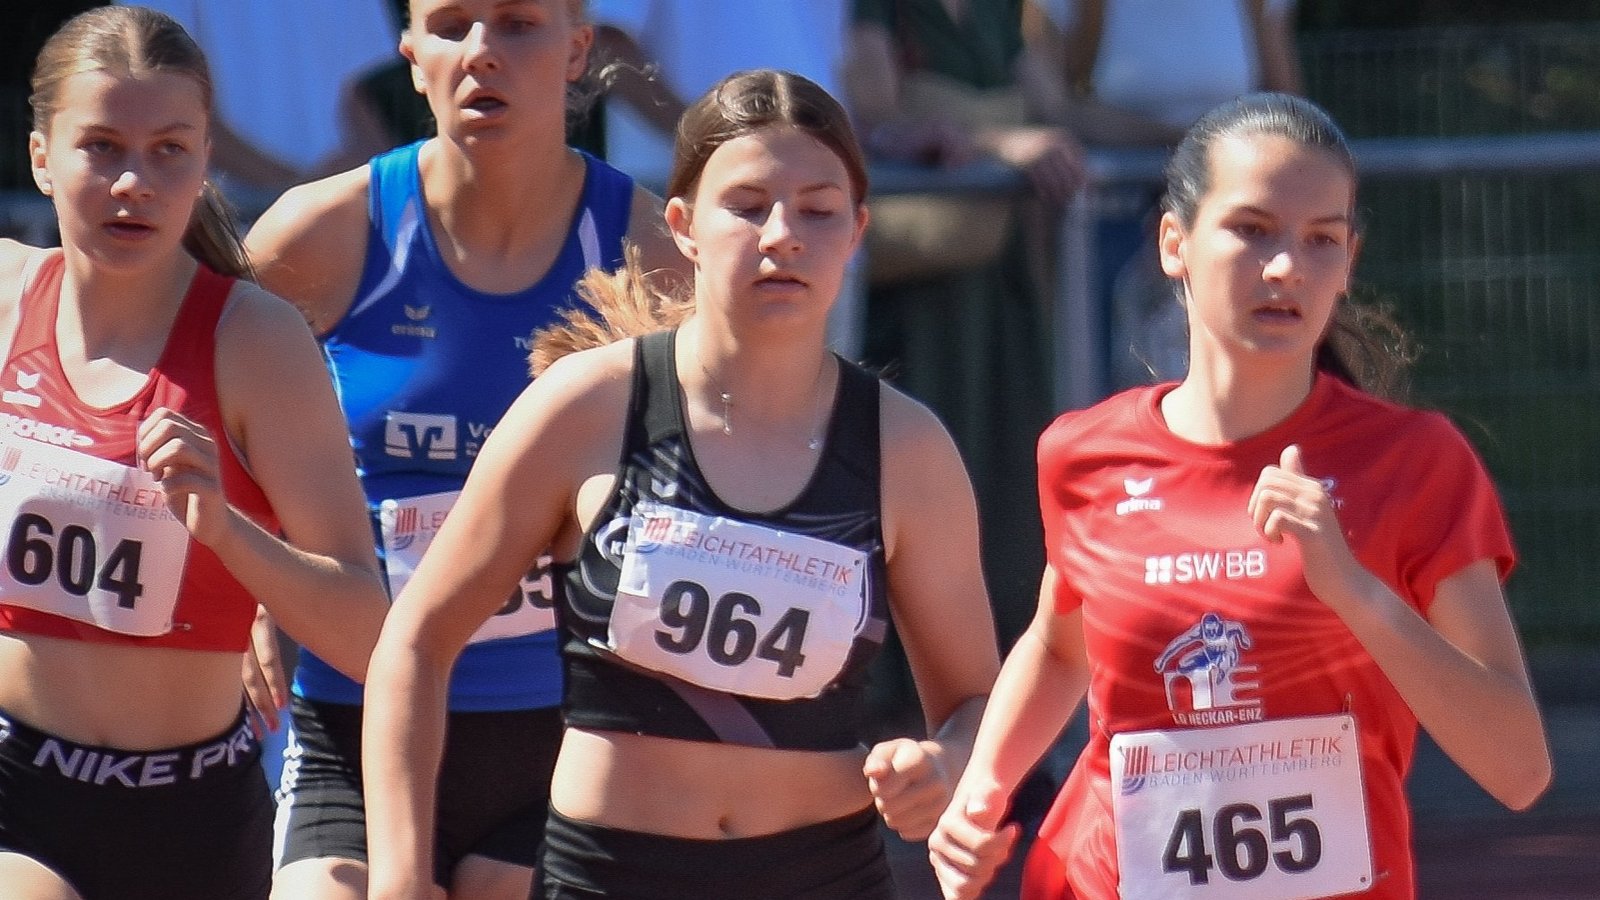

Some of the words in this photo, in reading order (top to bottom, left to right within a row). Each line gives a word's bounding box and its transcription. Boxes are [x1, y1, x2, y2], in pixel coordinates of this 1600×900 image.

[7, 513, 143, 610] 604
[671, 527, 854, 584] LEICHTATHLETIK
[654, 580, 811, 679] 964
[33, 739, 180, 788] NIKE
[190, 710, 254, 778] PR
[1151, 736, 1342, 774] LEICHTATHLETIK
[1162, 793, 1322, 886] 465
